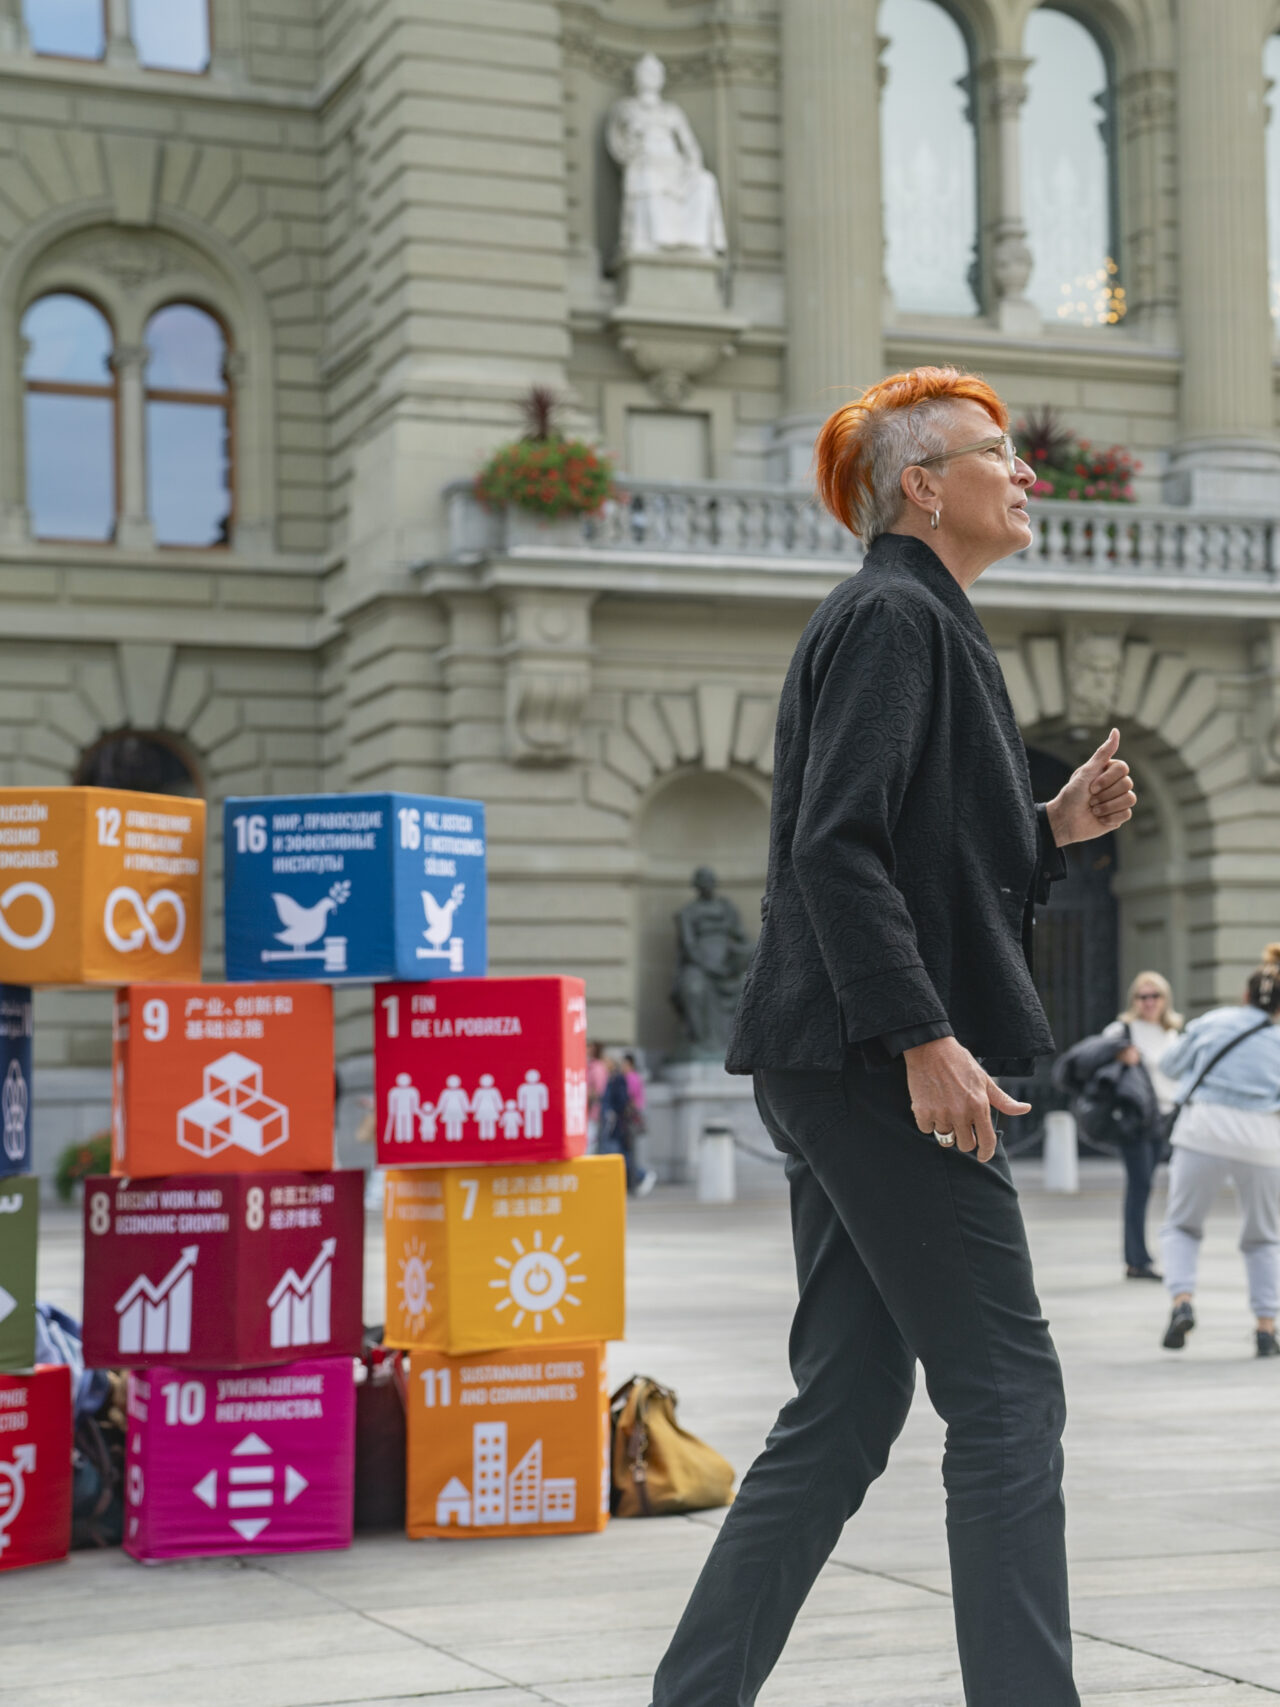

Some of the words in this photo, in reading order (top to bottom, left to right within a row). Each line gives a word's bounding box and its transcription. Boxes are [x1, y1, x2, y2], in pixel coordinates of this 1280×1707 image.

[96, 807, 121, 847] 12
[232, 814, 268, 853] 16
[398, 807, 421, 850] 16
[142, 998, 169, 1042] 9
[381, 995, 400, 1038] 1
[411, 995, 437, 1014] FIN
[411, 1019, 432, 1038] DE
[433, 1018, 453, 1037] LA
[454, 1016, 522, 1036] POBREZA
[89, 1191, 111, 1236] 8
[115, 1190, 158, 1211] DECENT
[160, 1189, 196, 1209] WORK
[196, 1189, 222, 1209] AND
[246, 1186, 264, 1231] 8
[459, 1179, 479, 1221] 7
[115, 1214, 177, 1235] ECONOMIC
[178, 1213, 230, 1233] GROWTH
[420, 1367, 451, 1407] 11
[460, 1363, 543, 1384] SUSTAINABLE
[545, 1361, 585, 1379] CITIES
[161, 1381, 206, 1426] 10
[460, 1388, 488, 1405] AND
[489, 1384, 577, 1404] COMMUNITIES
